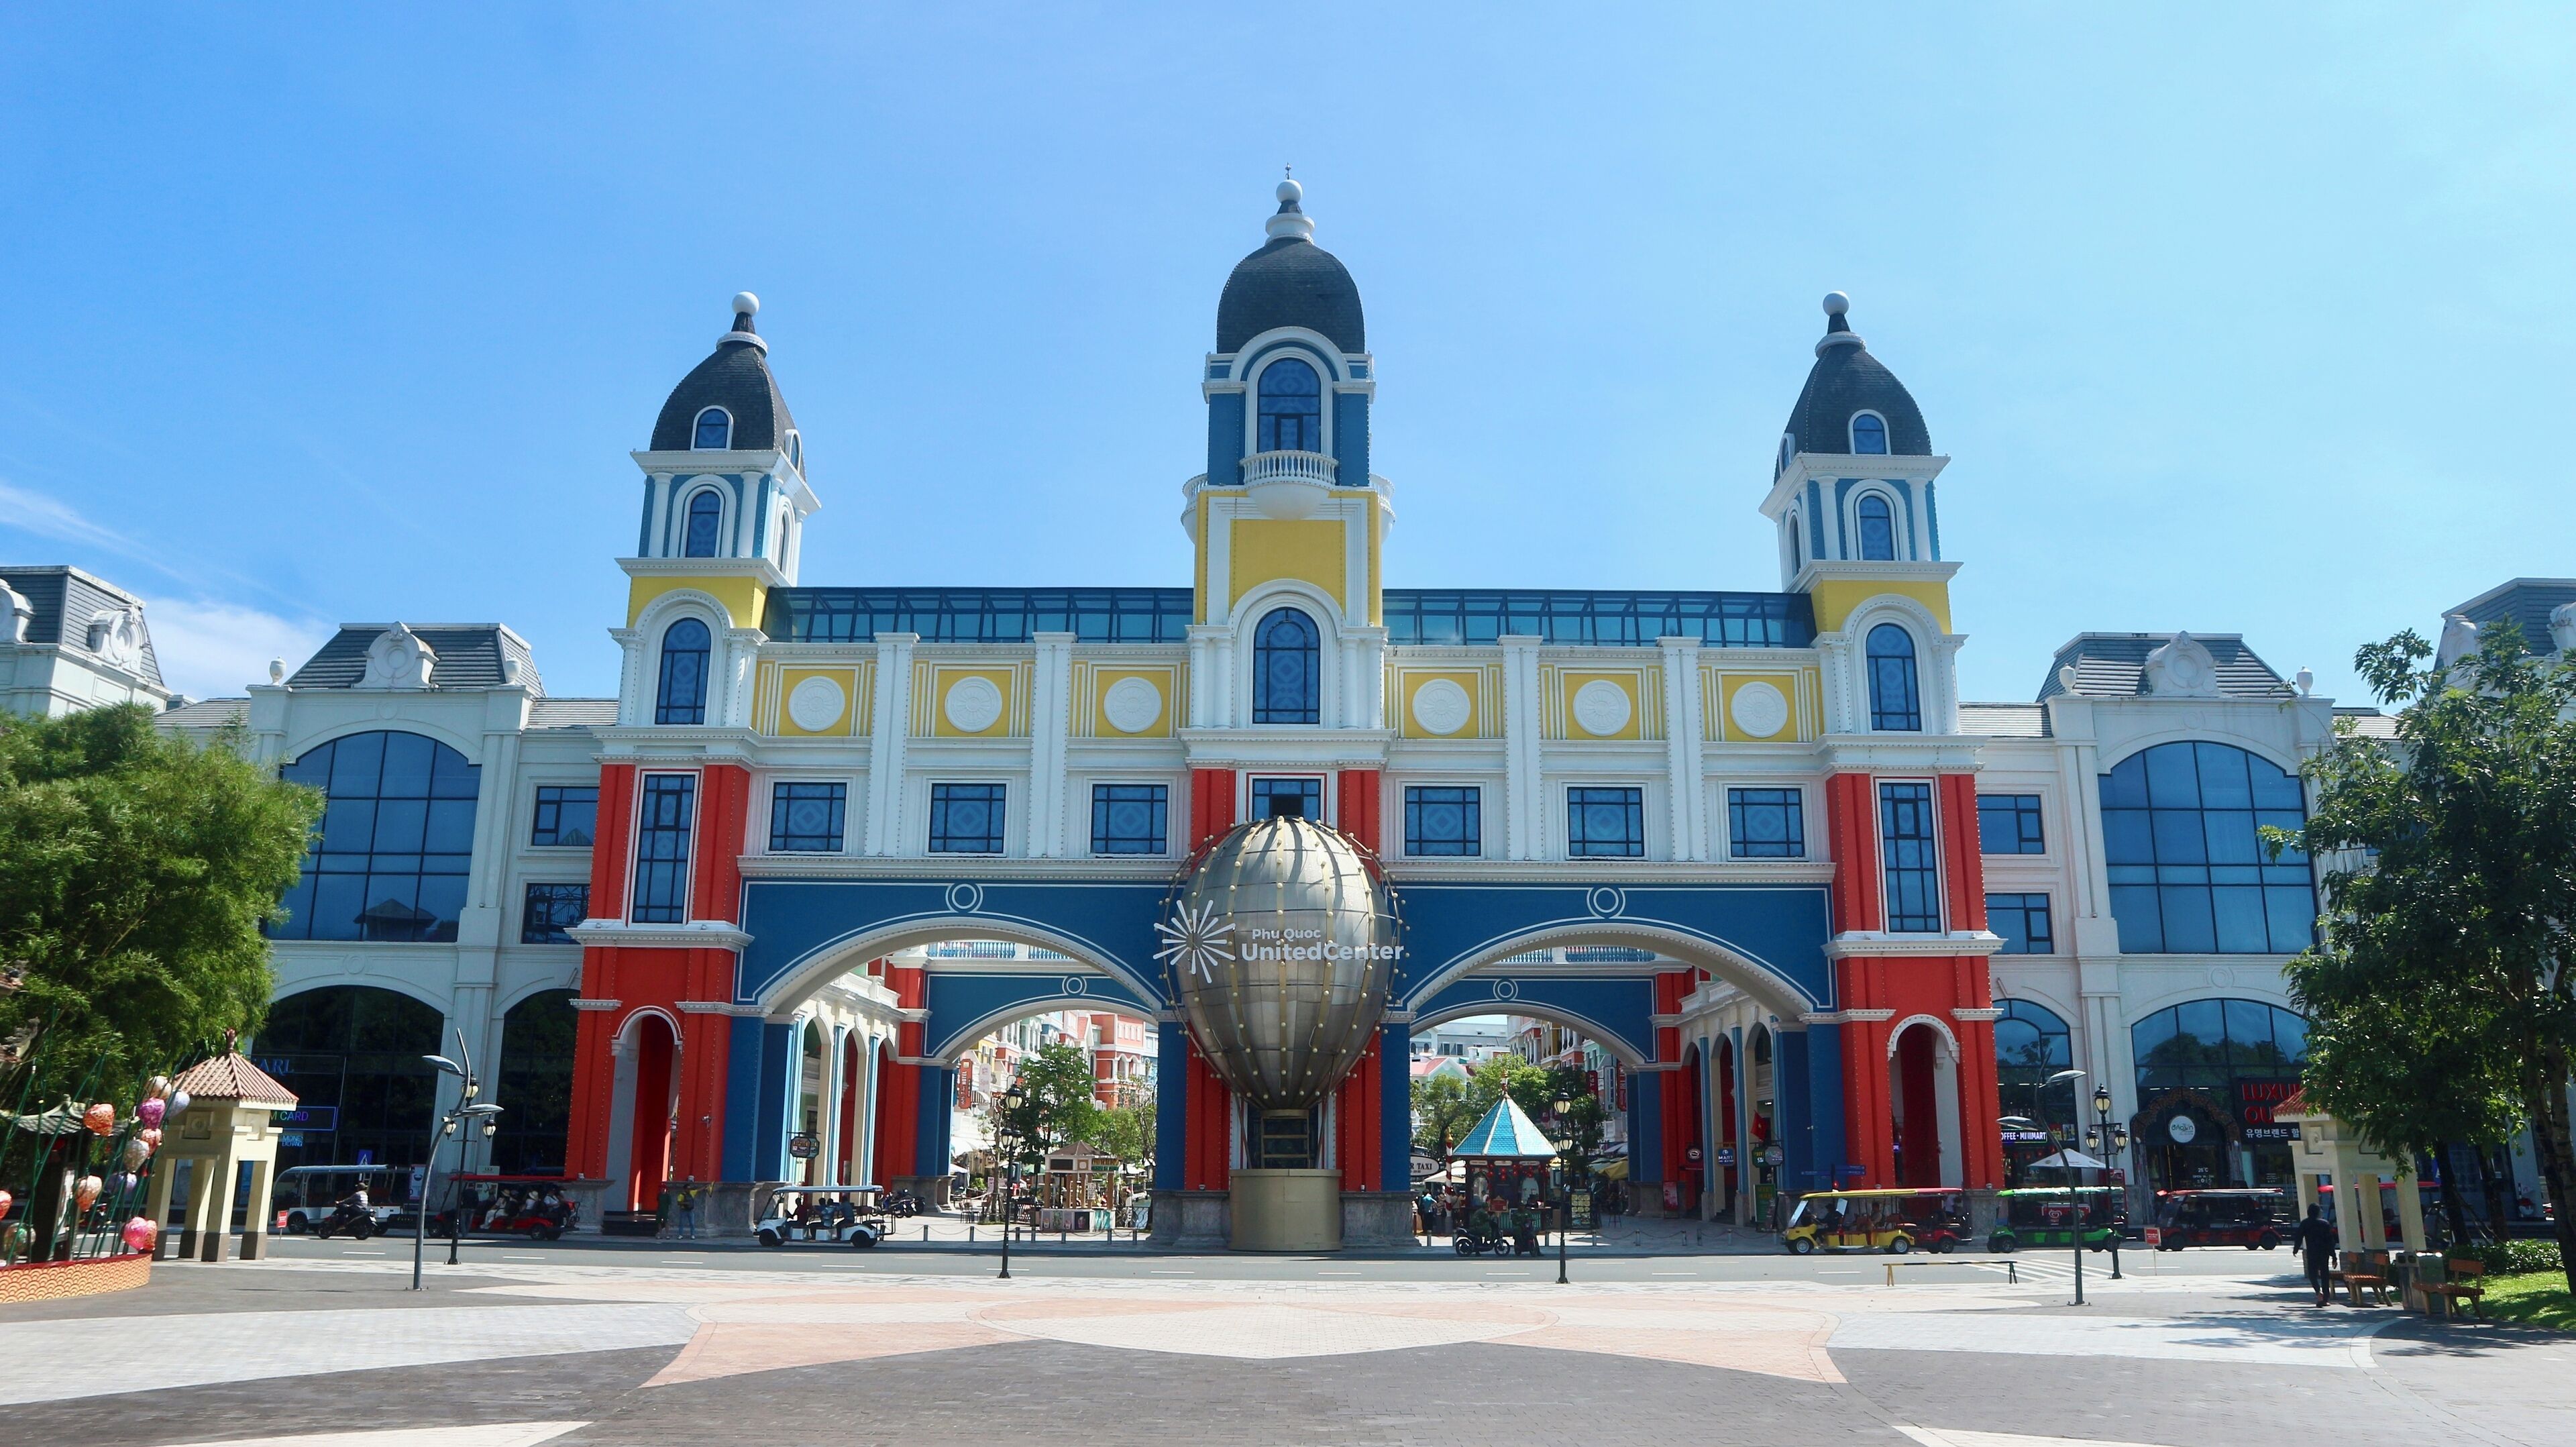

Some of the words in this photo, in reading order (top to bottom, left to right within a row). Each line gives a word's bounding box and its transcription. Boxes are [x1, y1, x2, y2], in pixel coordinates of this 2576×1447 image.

[1252, 928, 1281, 940] Phu
[1283, 928, 1322, 941] Quoc
[1241, 941, 1405, 961] UnitedCenter
[254, 1058, 295, 1077] ARL
[280, 1111, 309, 1121] CARD
[2019, 1131, 2046, 1140] MINIMART
